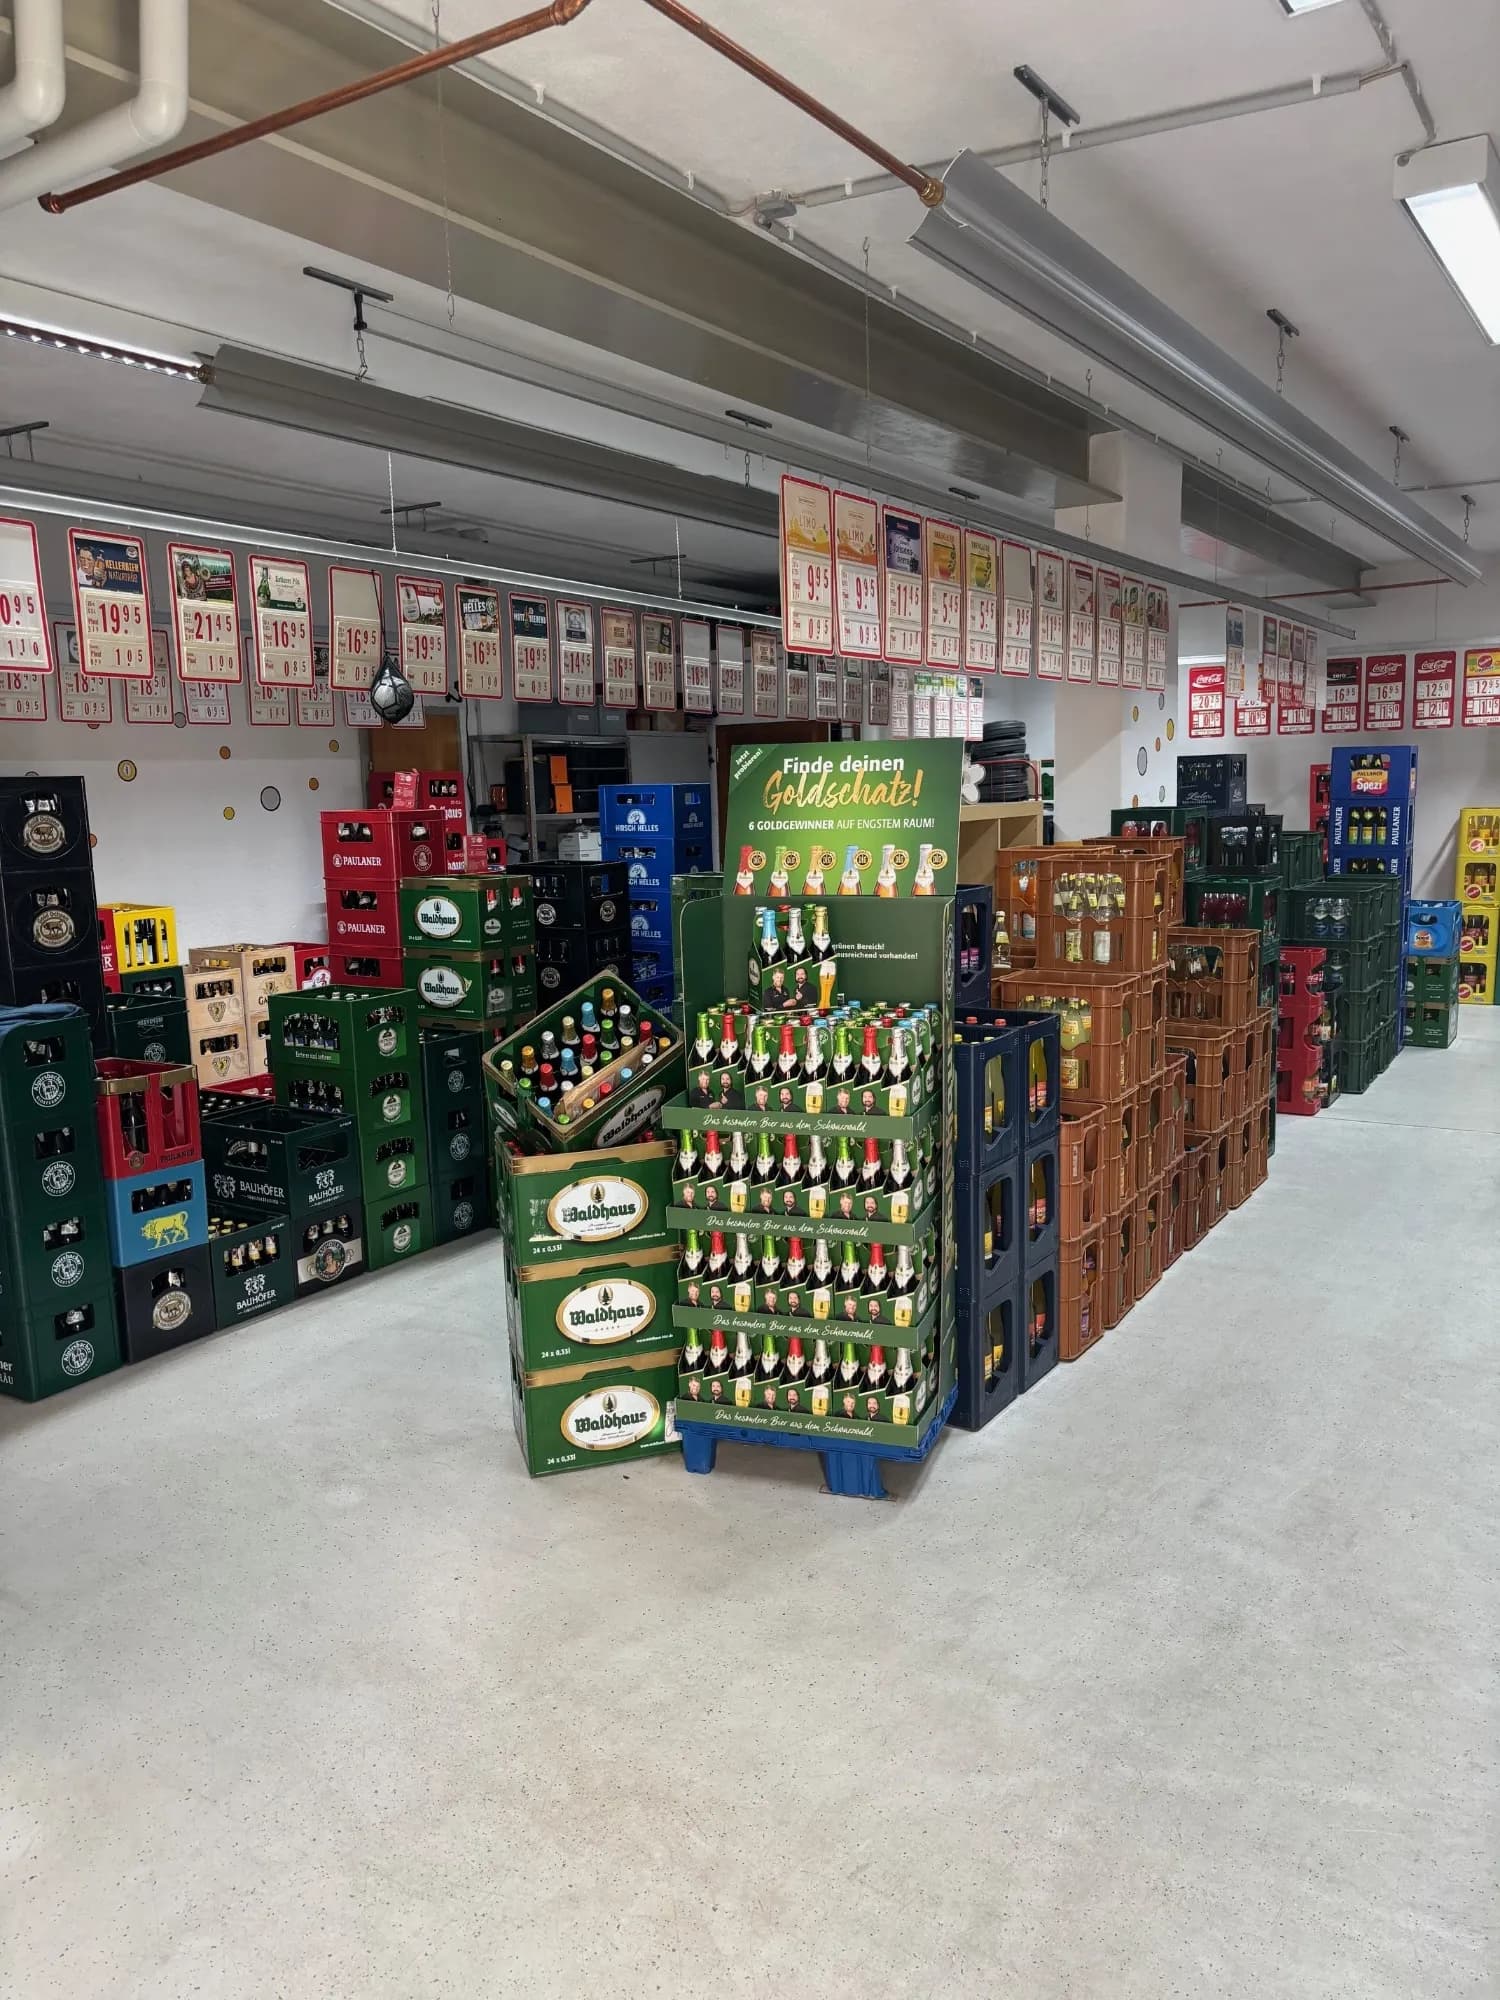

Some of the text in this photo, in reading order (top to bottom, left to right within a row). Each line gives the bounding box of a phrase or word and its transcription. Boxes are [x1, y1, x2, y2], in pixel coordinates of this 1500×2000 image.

[463, 602, 486, 613] HELLES
[734, 748, 763, 780] probieren!
[783, 755, 905, 774] Finde deinen
[763, 768, 924, 815] Goldschatz!
[1356, 778, 1382, 792] Spezi
[637, 823, 659, 832] HELLES
[748, 818, 935, 831] 6 GOLDGEWINNER AUF ENGSTEM RAUM!
[1334, 806, 1343, 845] PAULANER
[1392, 806, 1400, 845] PAULANER
[343, 856, 382, 867] PAULANER
[639, 878, 660, 886] HELLES
[347, 923, 386, 935] PAULANER
[421, 913, 457, 926] Waldhaus
[879, 952, 918, 960] vorhanden!
[603, 1096, 658, 1143] Waldhaus
[703, 1114, 720, 1126] Das
[722, 1116, 757, 1127] besondere
[760, 1117, 777, 1128] Bier
[796, 1119, 813, 1130] dem
[815, 1118, 867, 1133] Schwarzwald
[240, 1180, 284, 1198] BAUHÖFER
[308, 1184, 344, 1203] BAUHÖFER
[562, 1202, 636, 1224] Waldhaus
[706, 1215, 724, 1227] Das
[726, 1217, 760, 1229] besondere
[764, 1218, 781, 1230] Bier
[799, 1220, 815, 1232] dem
[816, 1223, 869, 1238] Schwarzwald
[236, 1289, 276, 1310] BAUHÖFER
[570, 1304, 645, 1326] Waldhaus
[713, 1315, 873, 1340] Das besondere Bier aus dem Schwarzwald
[541, 1351, 550, 1359] 24
[575, 1411, 647, 1433] Waldhaus
[715, 1409, 732, 1420] Das
[734, 1412, 768, 1425] besondere
[770, 1415, 787, 1426] Bier
[804, 1419, 820, 1431] dem
[822, 1421, 873, 1437] Schwarzwald
[547, 1457, 556, 1465] 24
